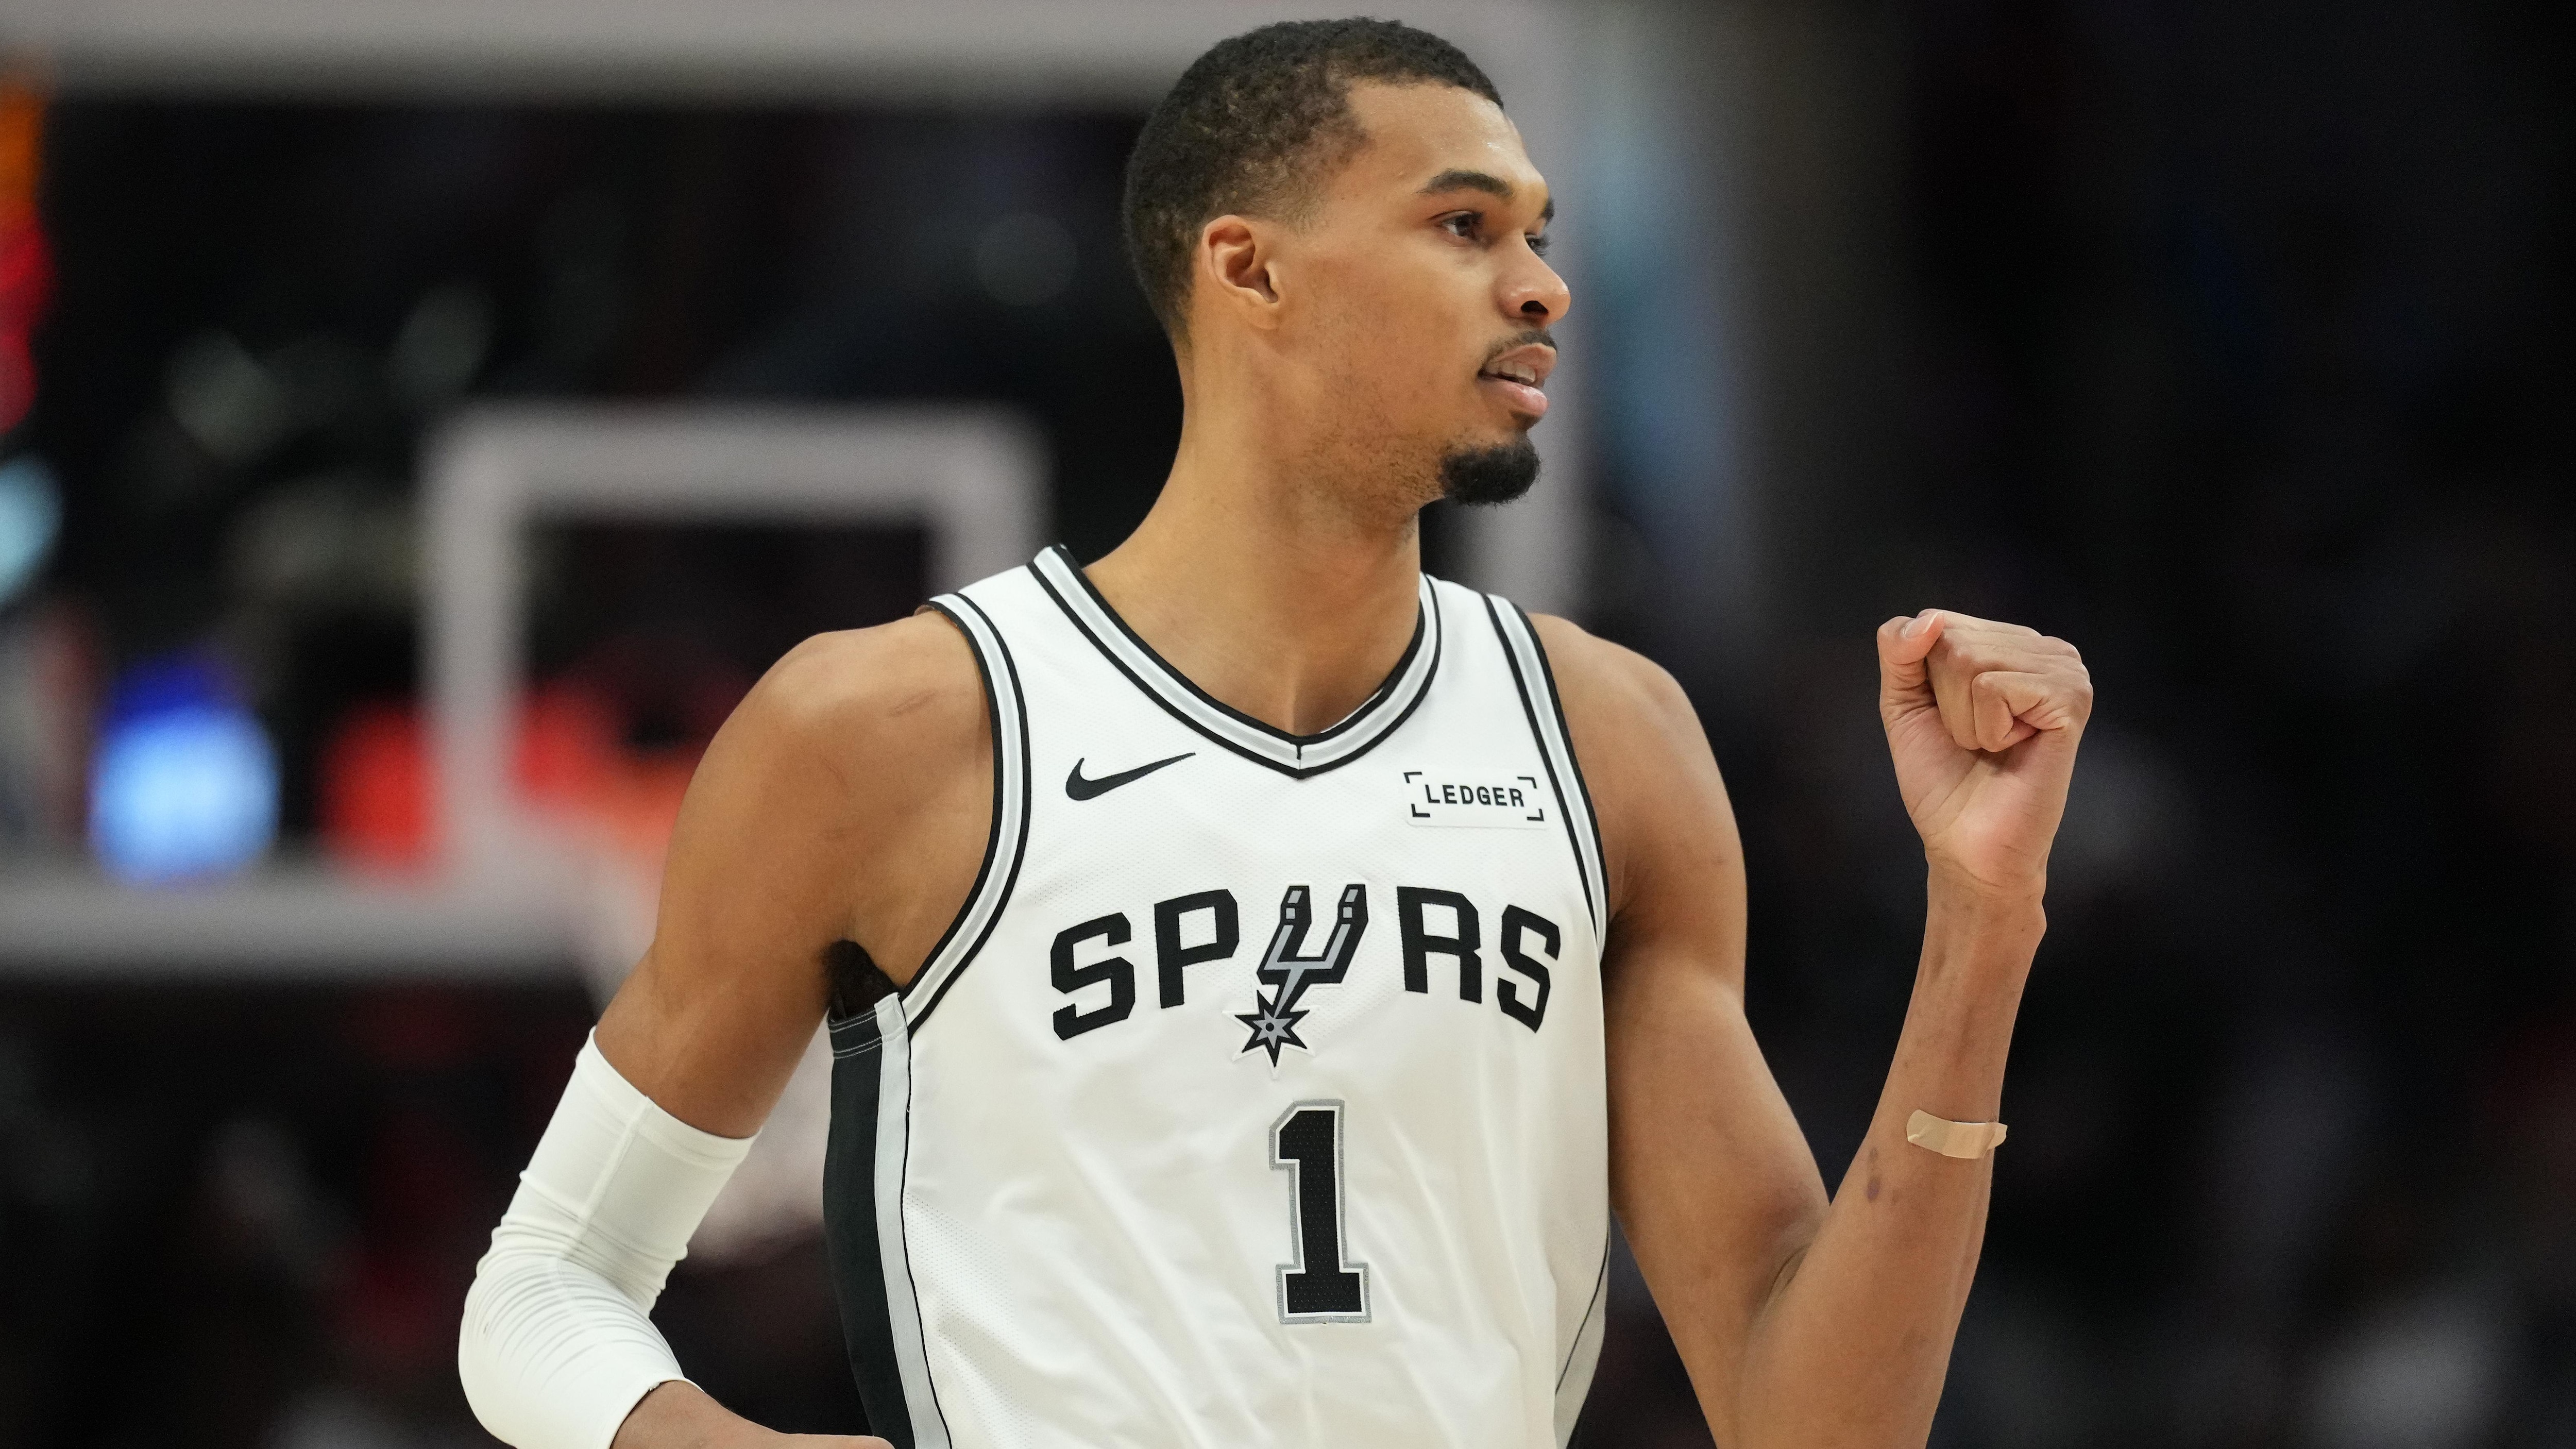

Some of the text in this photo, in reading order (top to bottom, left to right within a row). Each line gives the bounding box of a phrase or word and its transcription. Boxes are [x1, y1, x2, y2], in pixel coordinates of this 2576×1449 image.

[1425, 784, 1525, 807] LEDGER
[1050, 883, 1562, 1069] SPURS
[1269, 1099, 1372, 1324] 1
